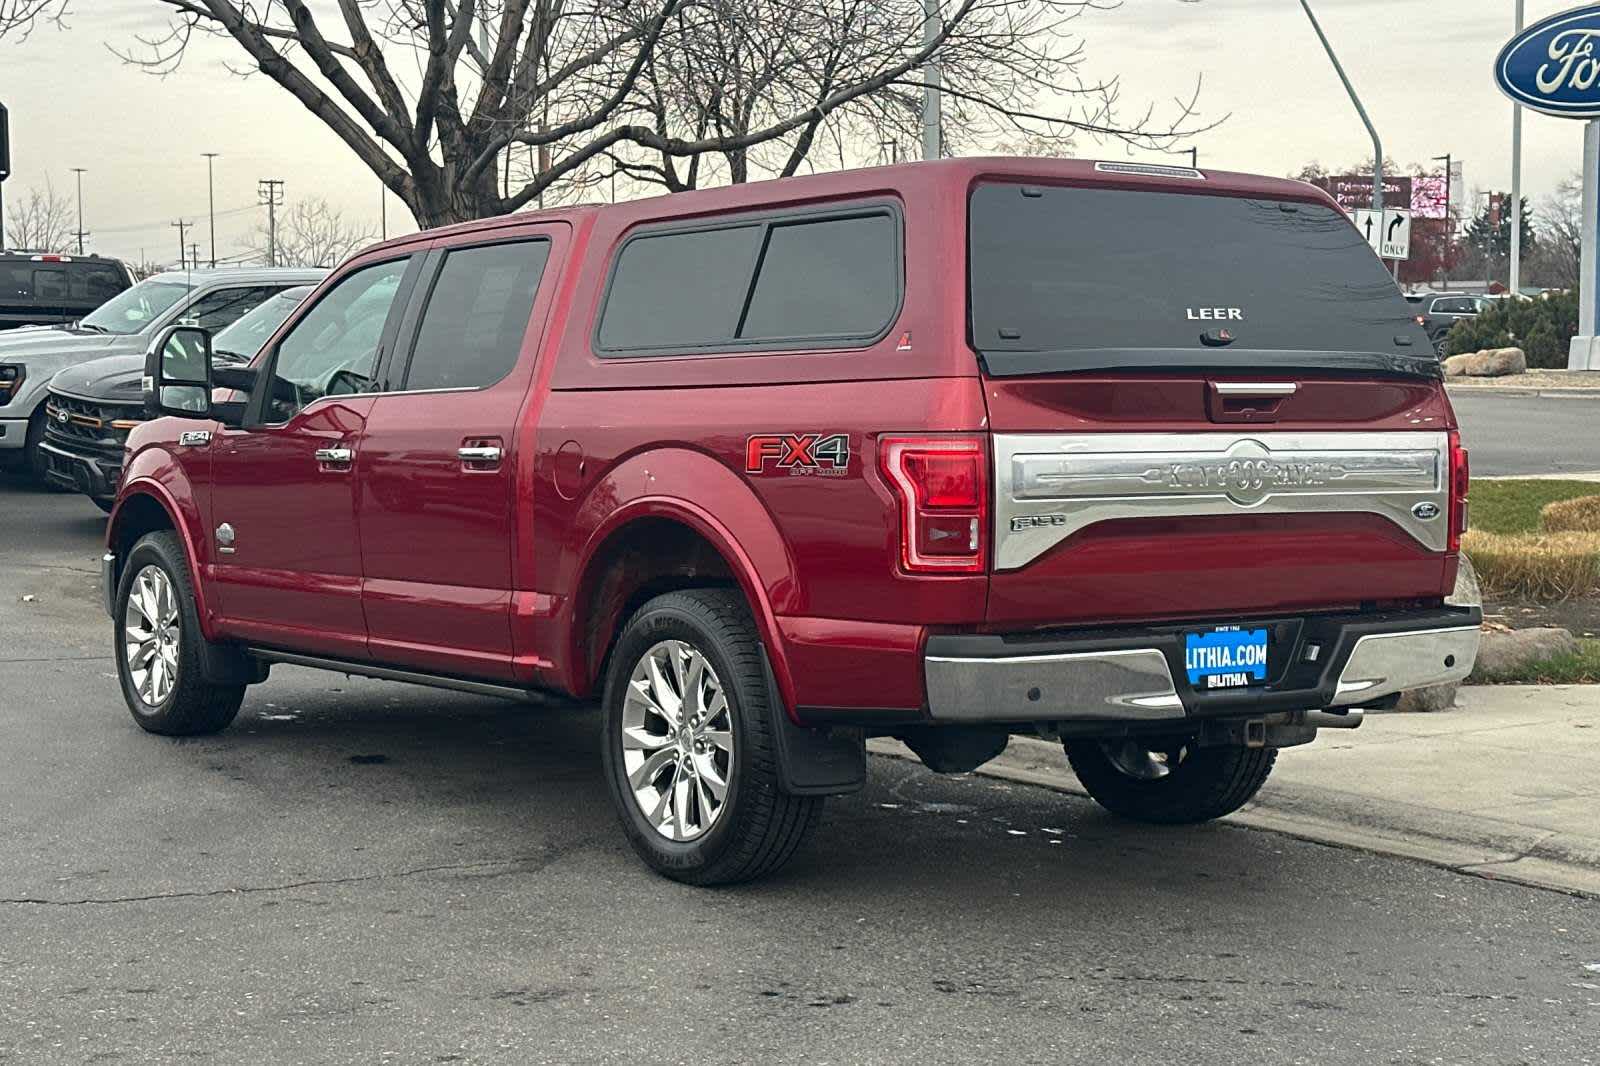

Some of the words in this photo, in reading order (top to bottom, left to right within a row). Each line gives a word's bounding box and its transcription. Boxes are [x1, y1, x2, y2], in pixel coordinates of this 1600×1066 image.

[1536, 28, 1600, 94] Fo
[1384, 245, 1405, 255] ONLY
[1186, 308, 1243, 320] LEER
[746, 433, 850, 473] FX4
[1168, 463, 1227, 487] KING
[1186, 645, 1267, 669] LITHIA.COM
[1216, 673, 1248, 687] LITHIA
